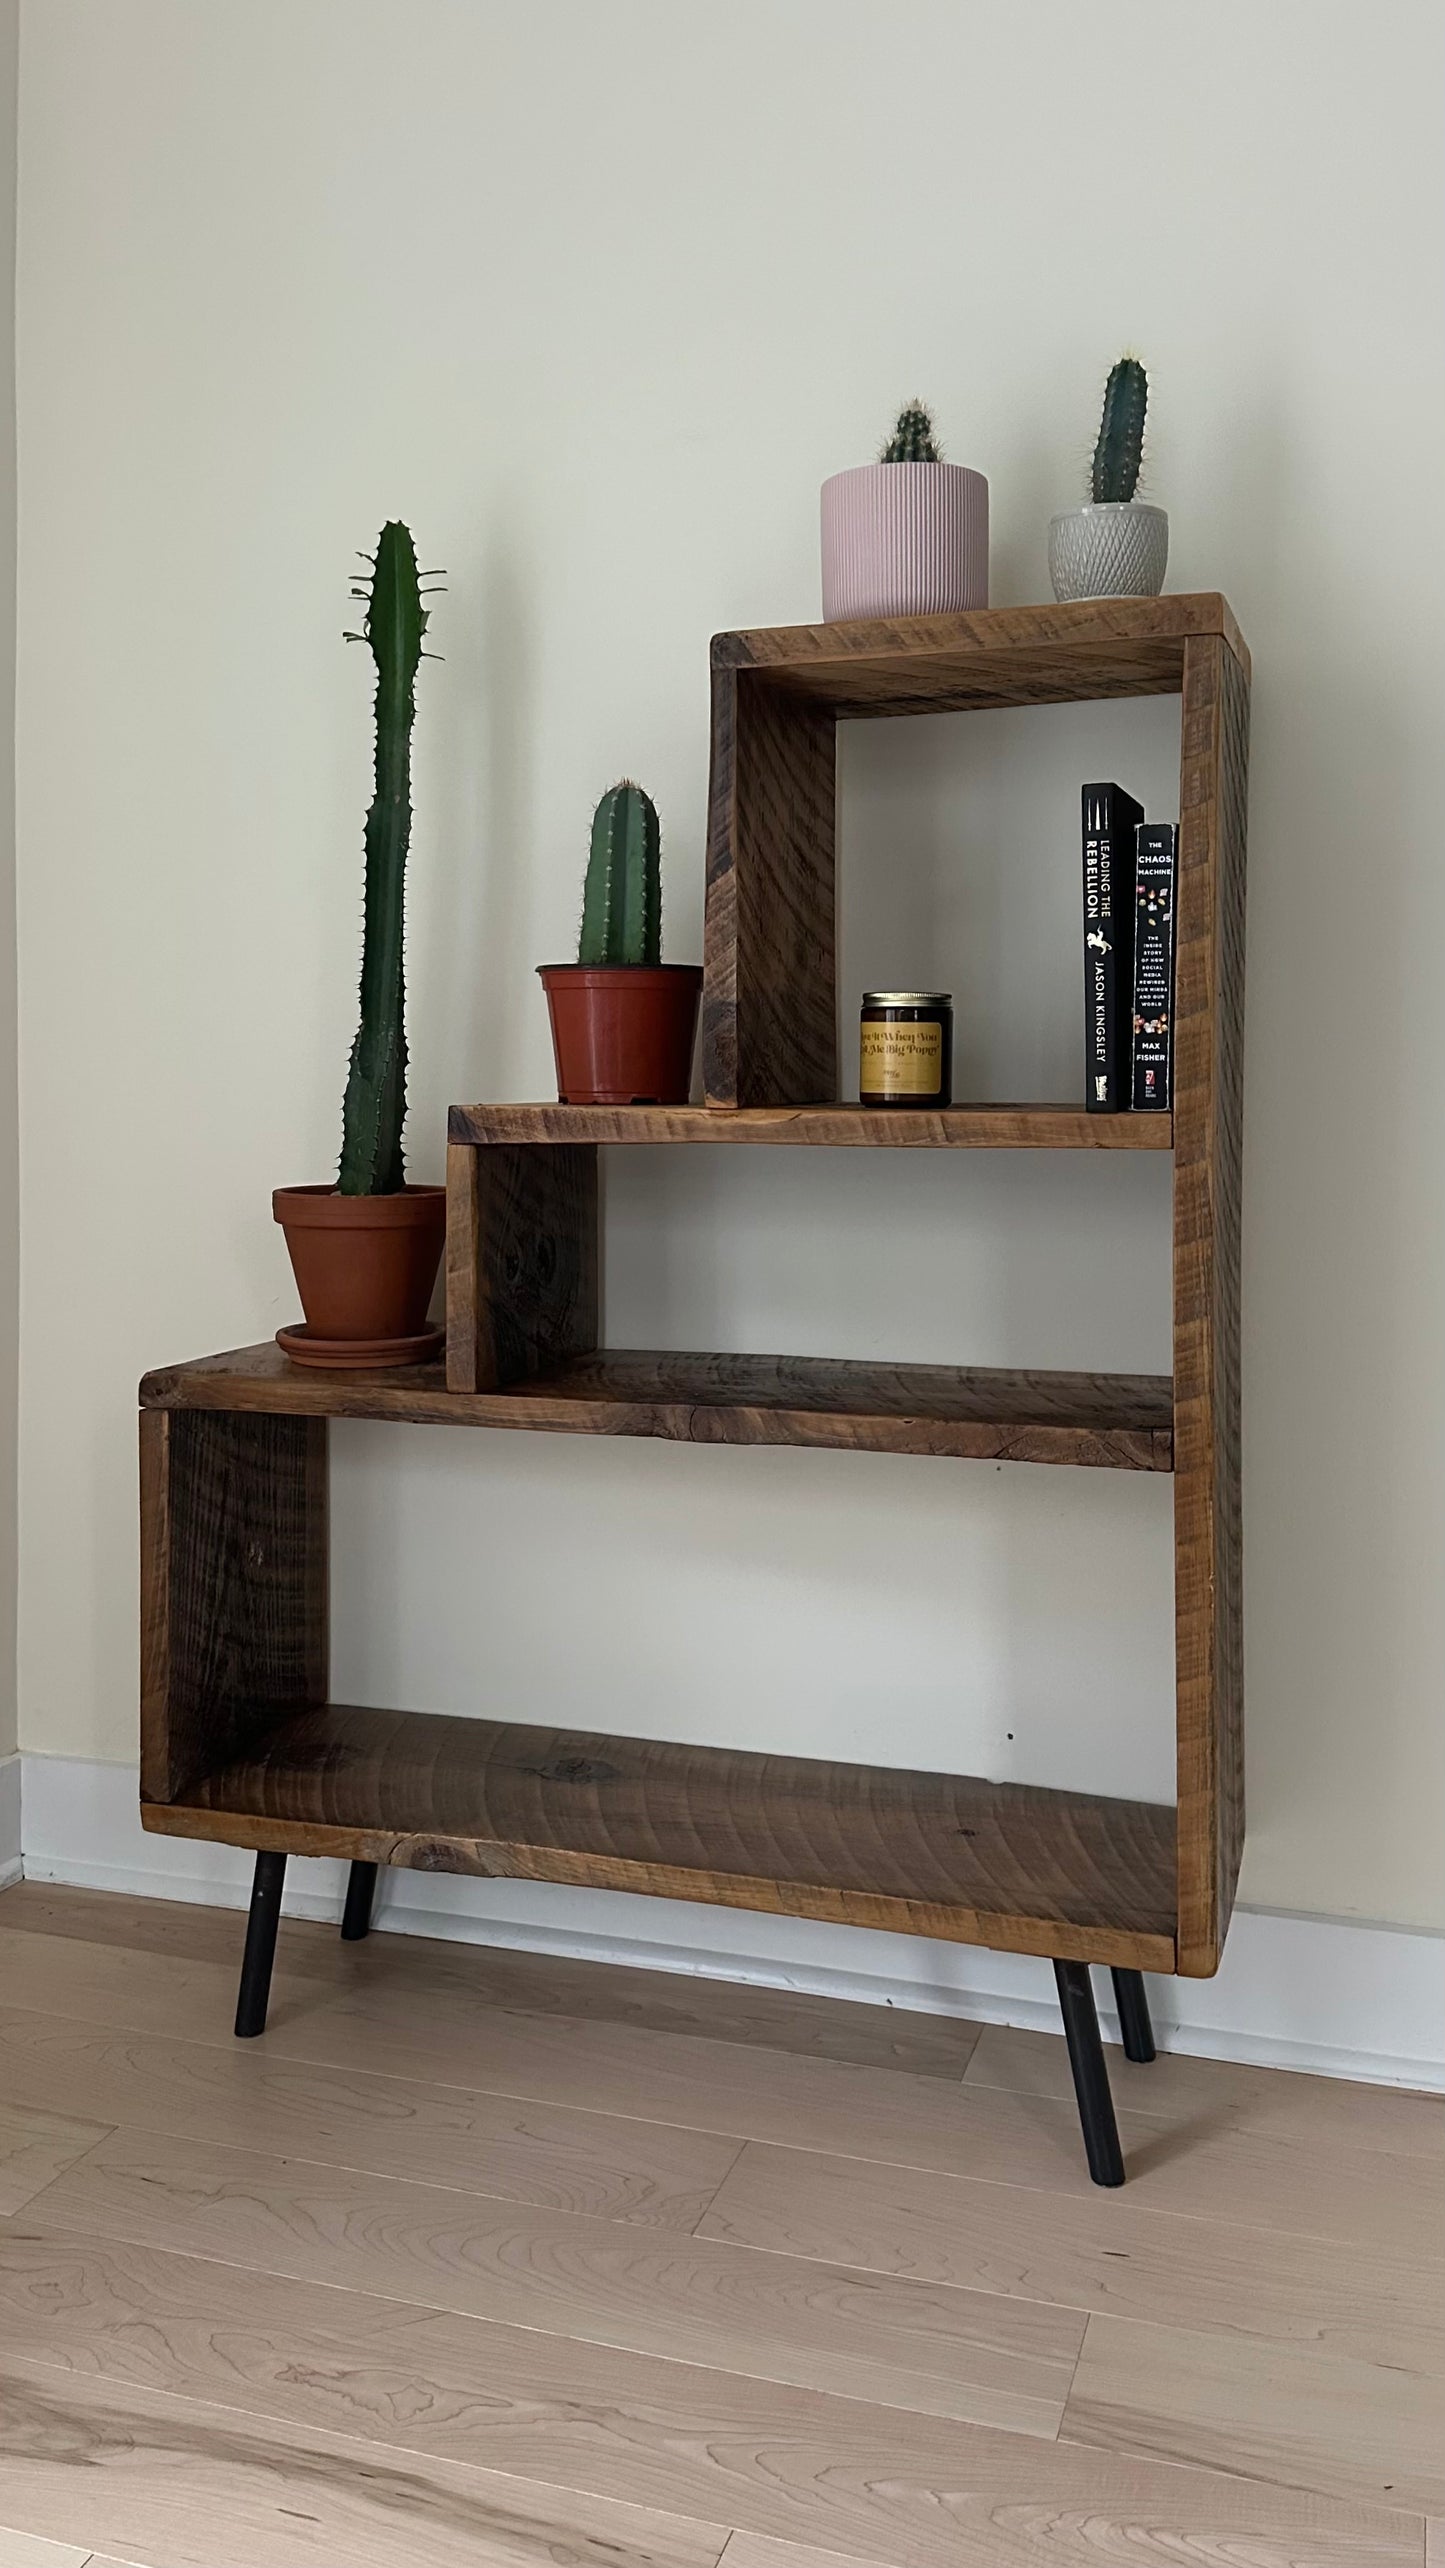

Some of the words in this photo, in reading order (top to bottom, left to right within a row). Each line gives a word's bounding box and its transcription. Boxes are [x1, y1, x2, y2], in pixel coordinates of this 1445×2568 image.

[1086, 840, 1099, 919] REBELLION
[1100, 840, 1111, 892] LEADING
[1138, 855, 1172, 864] CHAOS
[1101, 896, 1111, 918] THE
[1095, 961, 1105, 1001] JASON
[1095, 1005, 1106, 1062] KINGSLEY
[1141, 1042, 1161, 1050] MAX
